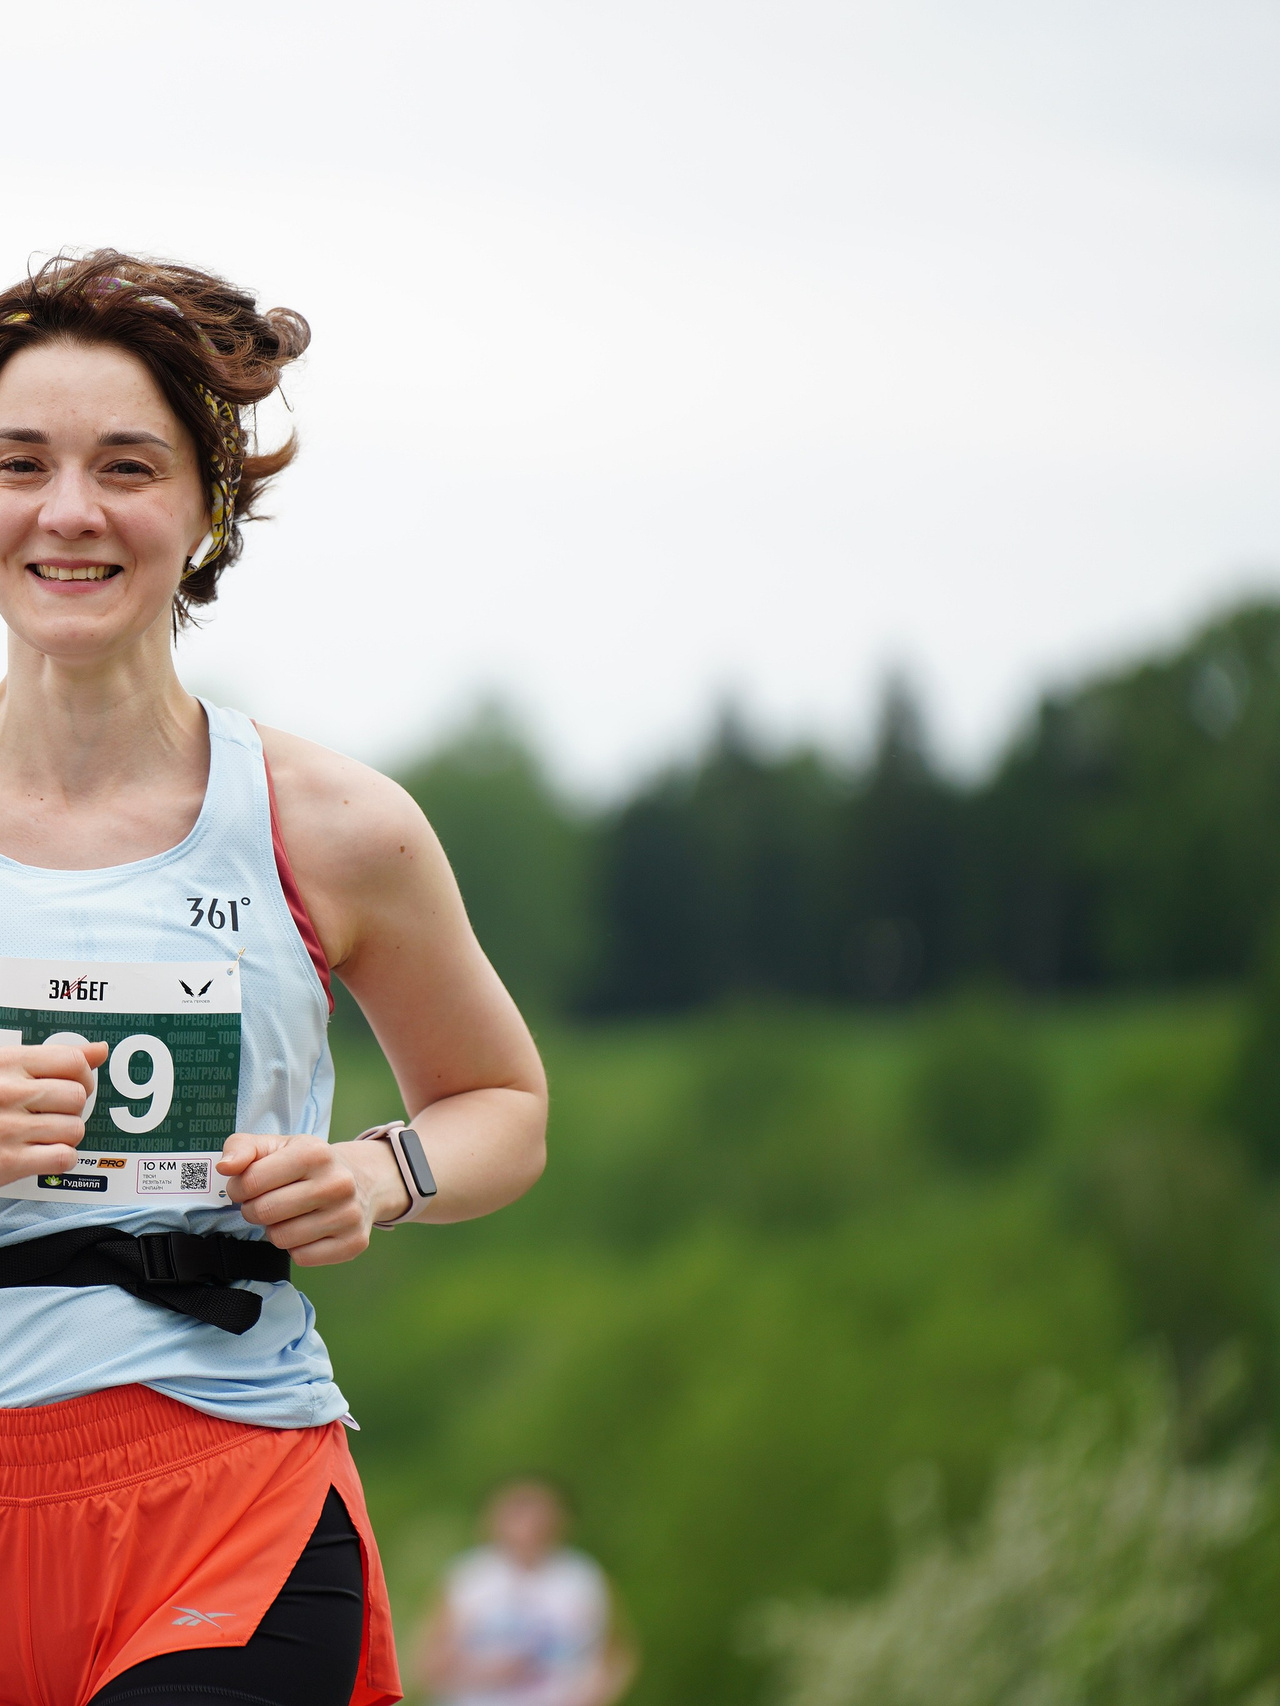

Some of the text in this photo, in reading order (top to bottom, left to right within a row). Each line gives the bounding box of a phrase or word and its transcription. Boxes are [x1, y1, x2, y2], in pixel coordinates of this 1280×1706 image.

[186, 897, 251, 932] 361°
[37, 1010, 81, 1024] БЕГОВАЯ
[82, 1012, 155, 1026] ПЕРЕЗАГРУЗКА
[173, 1014, 209, 1026] СТРЕСС
[167, 1031, 206, 1045] ФИНИШ
[176, 1049, 194, 1062] ВСЕ
[195, 1049, 220, 1062] СПЯТ
[181, 1085, 225, 1099] СЕРДЦЕМ
[86, 1137, 99, 1149] НА
[100, 1137, 138, 1151] СТАРТЕ
[138, 1138, 173, 1151] ЖИЗНИ
[99, 1160, 125, 1168] PRO
[143, 1161, 156, 1171] 10
